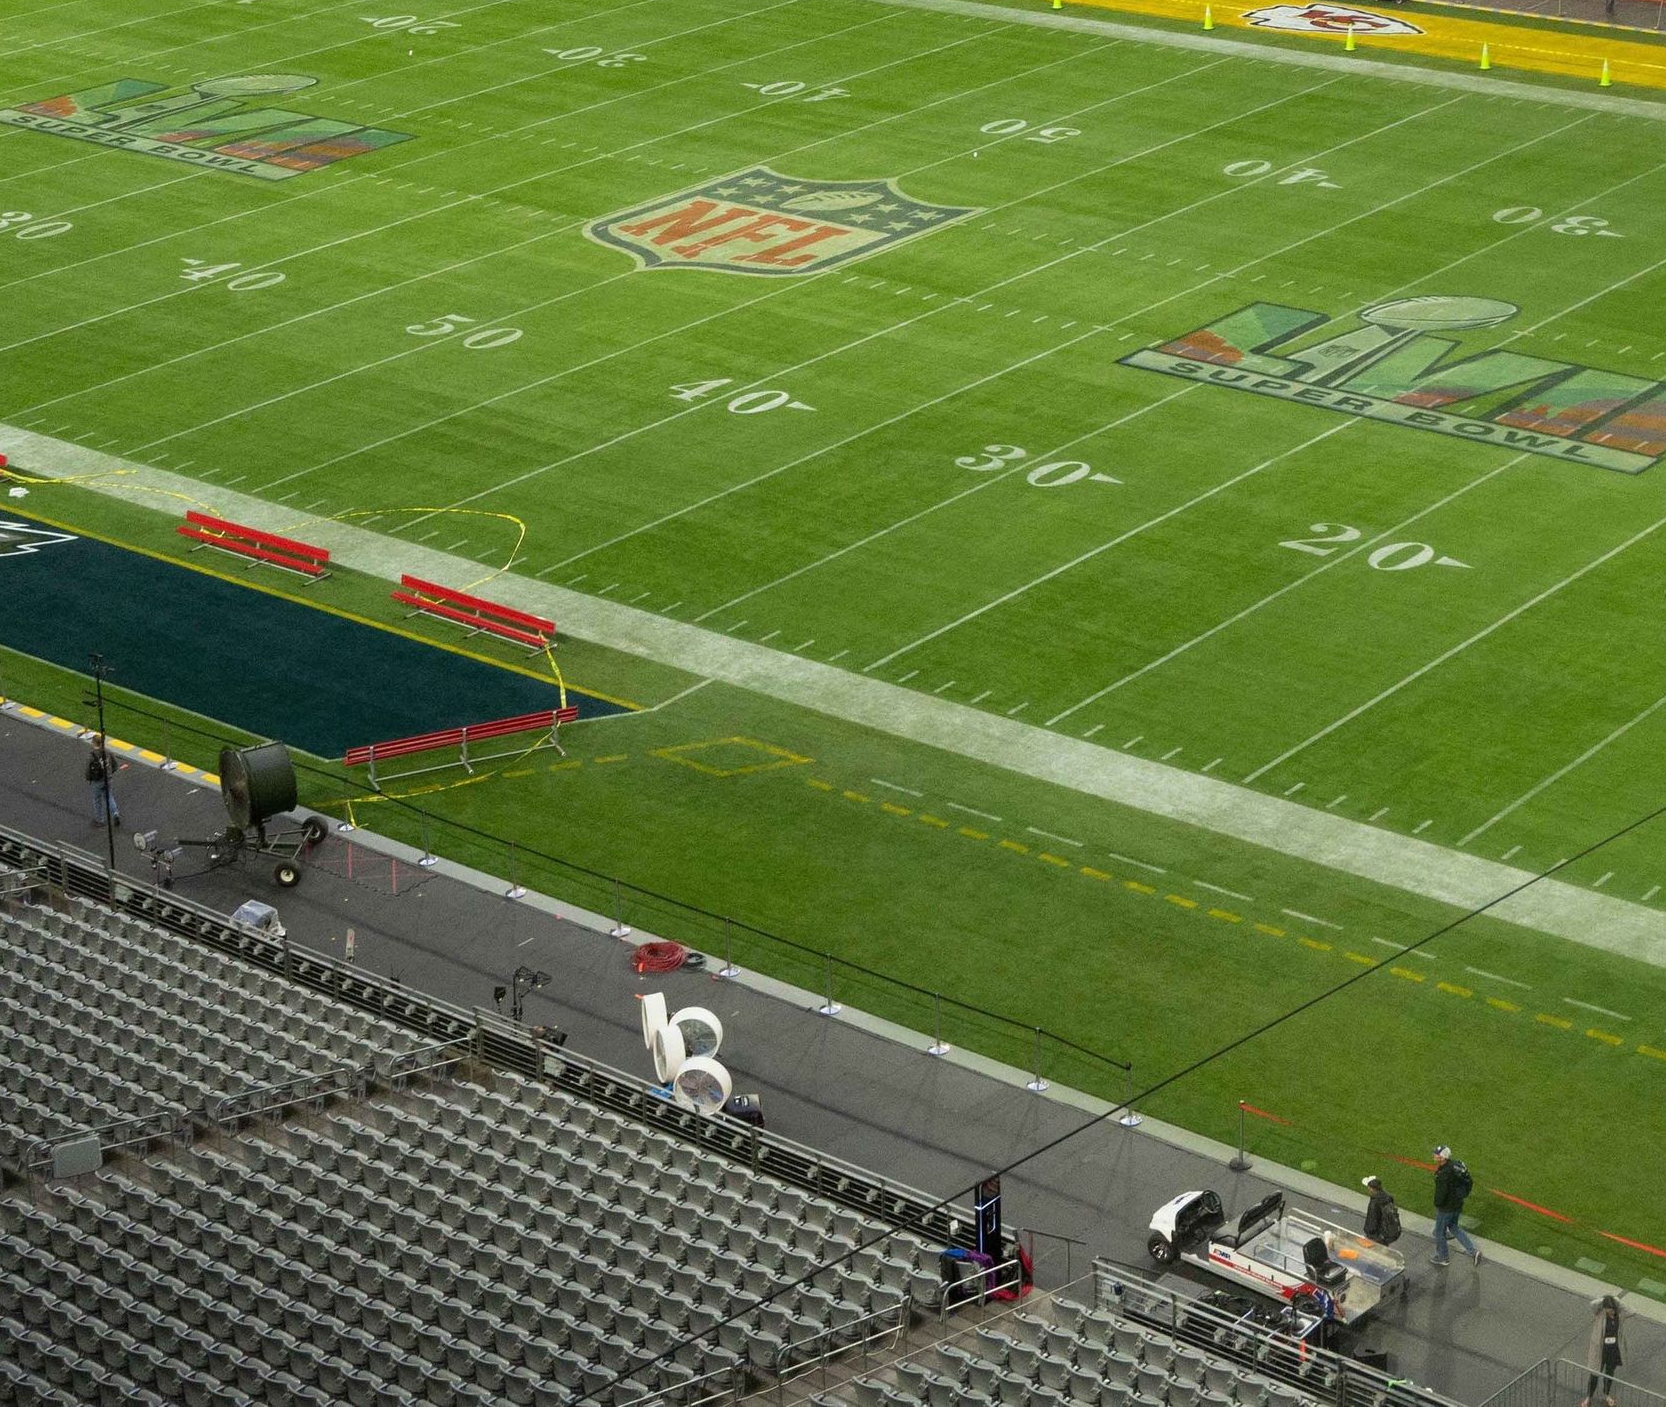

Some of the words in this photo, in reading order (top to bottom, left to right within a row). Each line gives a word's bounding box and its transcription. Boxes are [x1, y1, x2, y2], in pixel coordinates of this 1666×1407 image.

[11, 115, 137, 146] SUPER
[155, 144, 260, 175] BOWL
[617, 199, 852, 267] NFL
[1166, 359, 1385, 412] SUPER
[1403, 410, 1596, 461] BOWL
